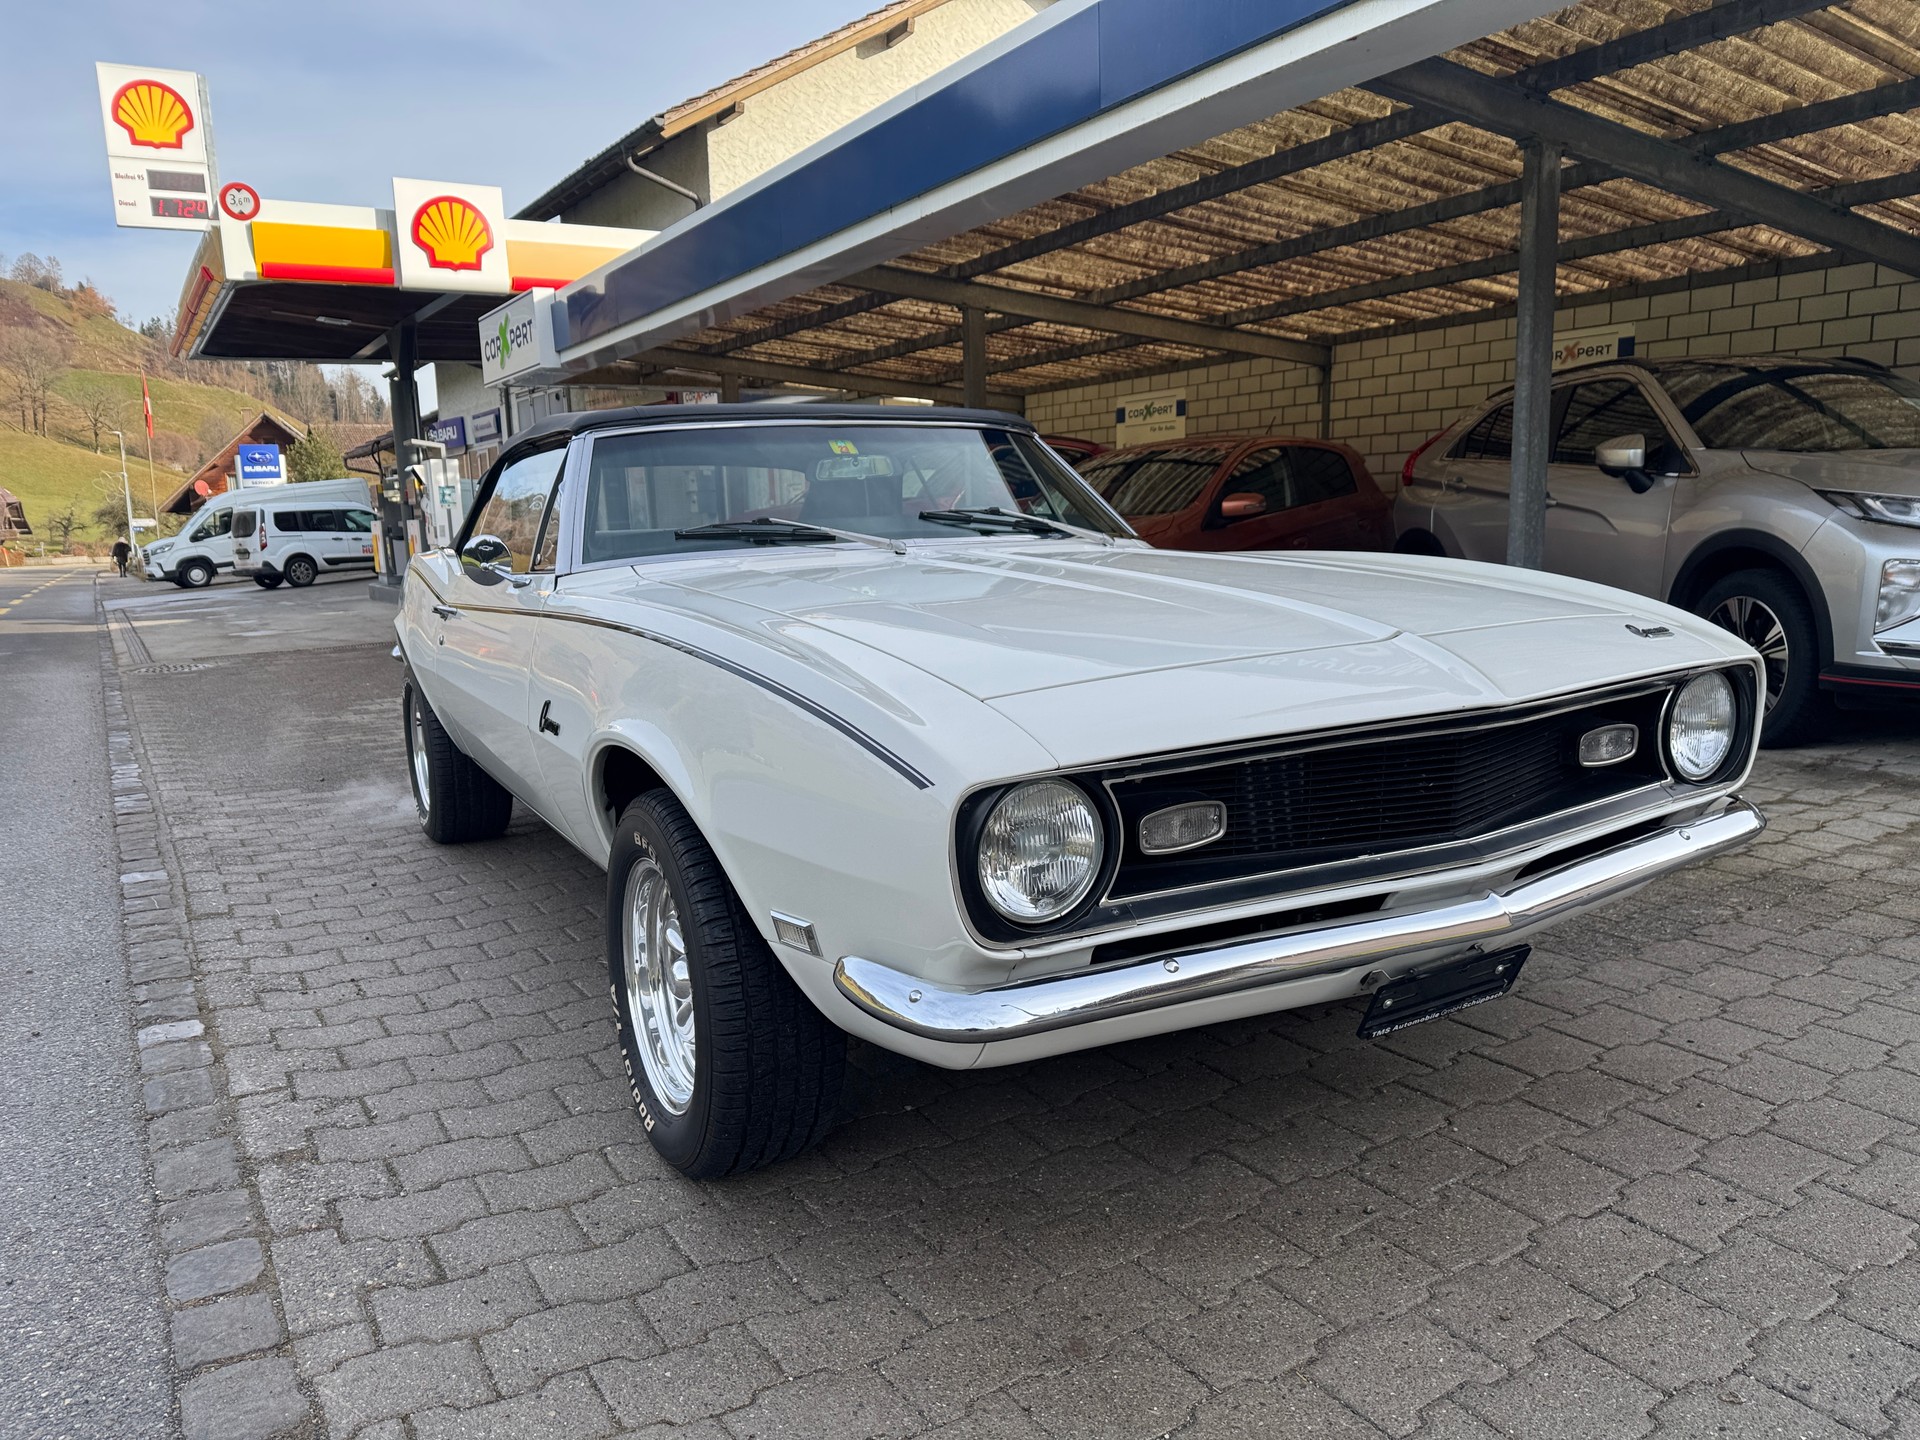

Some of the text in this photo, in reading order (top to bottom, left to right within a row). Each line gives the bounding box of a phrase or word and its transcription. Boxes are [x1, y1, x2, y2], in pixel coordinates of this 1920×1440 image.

[118, 199, 137, 207] Diesel
[1372, 1027, 1391, 1038] TMS
[1392, 1012, 1440, 1032] Automobile
